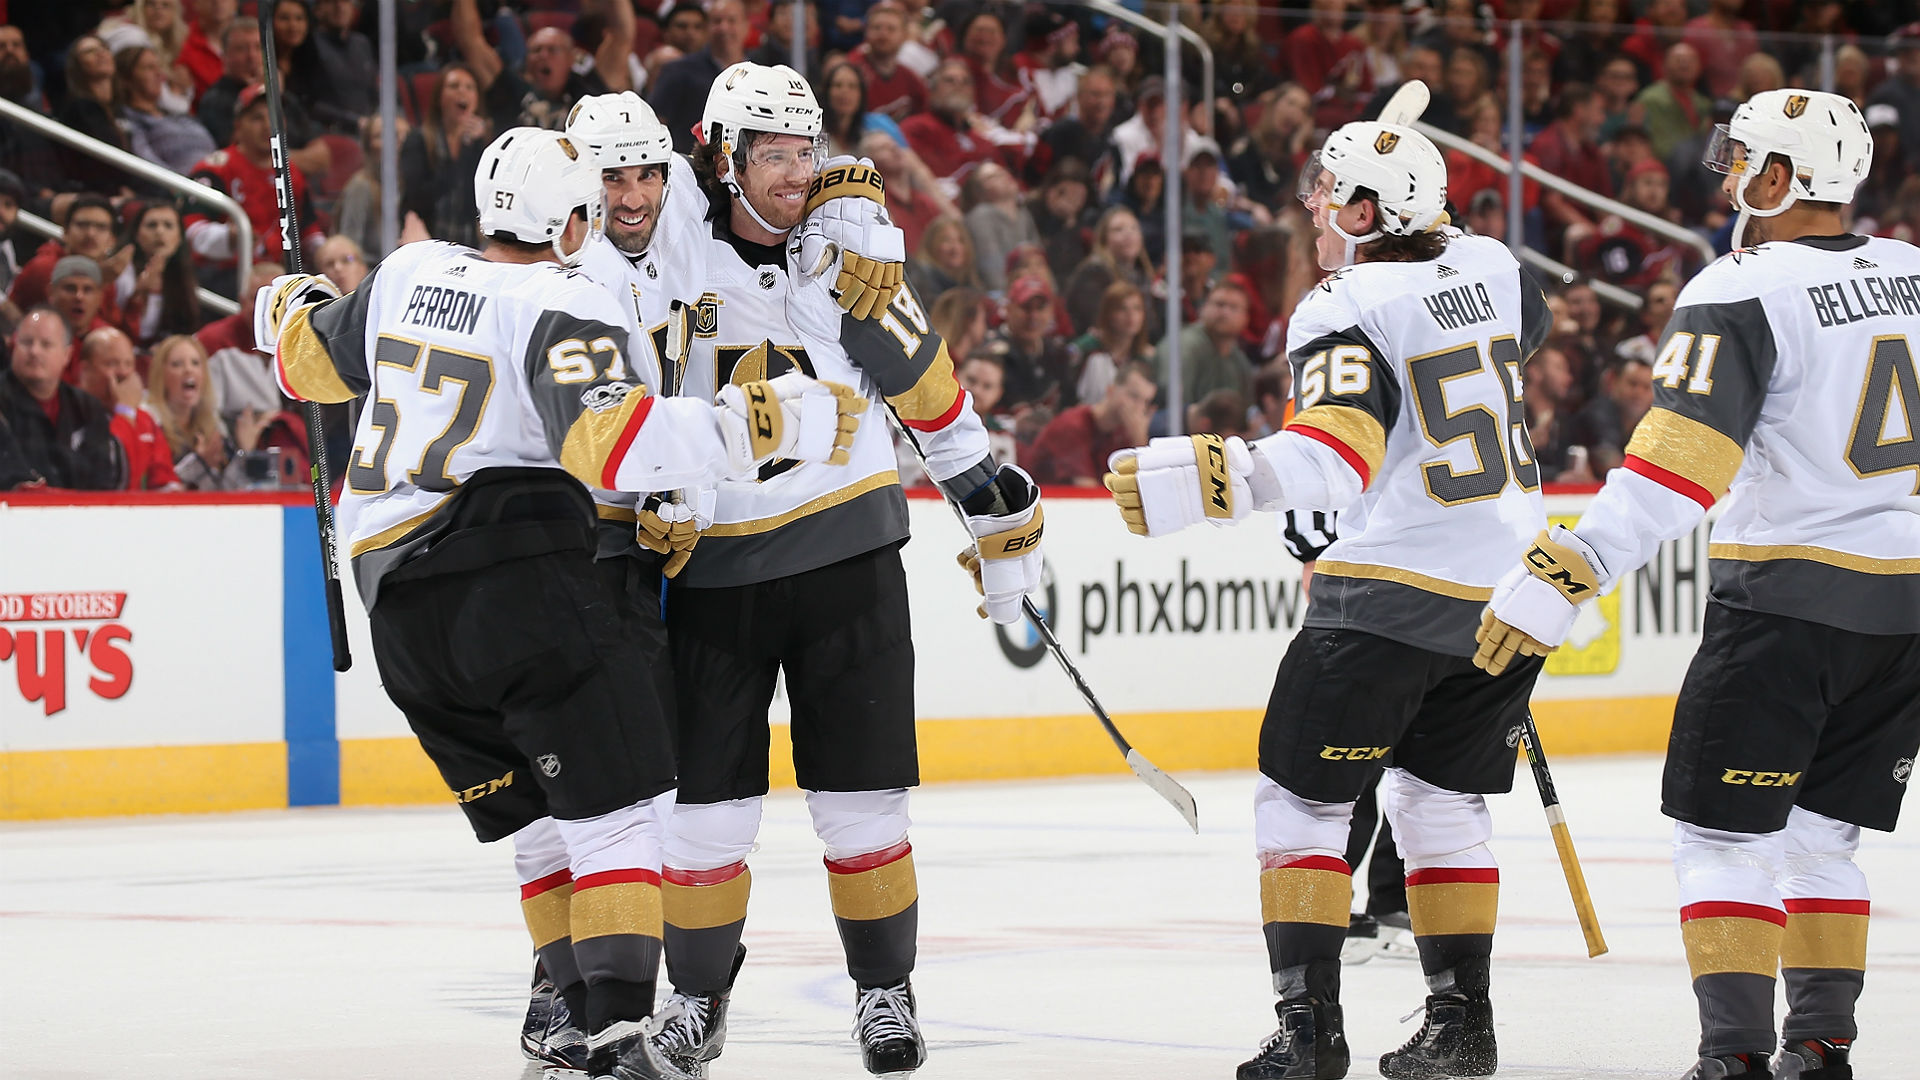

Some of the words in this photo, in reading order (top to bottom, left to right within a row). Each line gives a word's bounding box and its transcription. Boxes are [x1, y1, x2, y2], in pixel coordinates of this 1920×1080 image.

[619, 112, 631, 123] 7
[784, 106, 814, 116] CCM
[270, 134, 292, 250] CCM
[494, 191, 514, 210] 57
[401, 285, 487, 335] PERRON
[879, 281, 930, 359] 18
[1423, 282, 1498, 330] HAULA
[547, 336, 627, 384] 57
[1301, 345, 1372, 409] 56
[1651, 331, 1721, 395] 41
[348, 333, 496, 494] 57
[1635, 521, 1712, 634] NH
[31, 593, 117, 618] STORES
[1082, 559, 1301, 654] phxbmw
[1320, 744, 1391, 761] CCM
[1720, 768, 1802, 787] CCM
